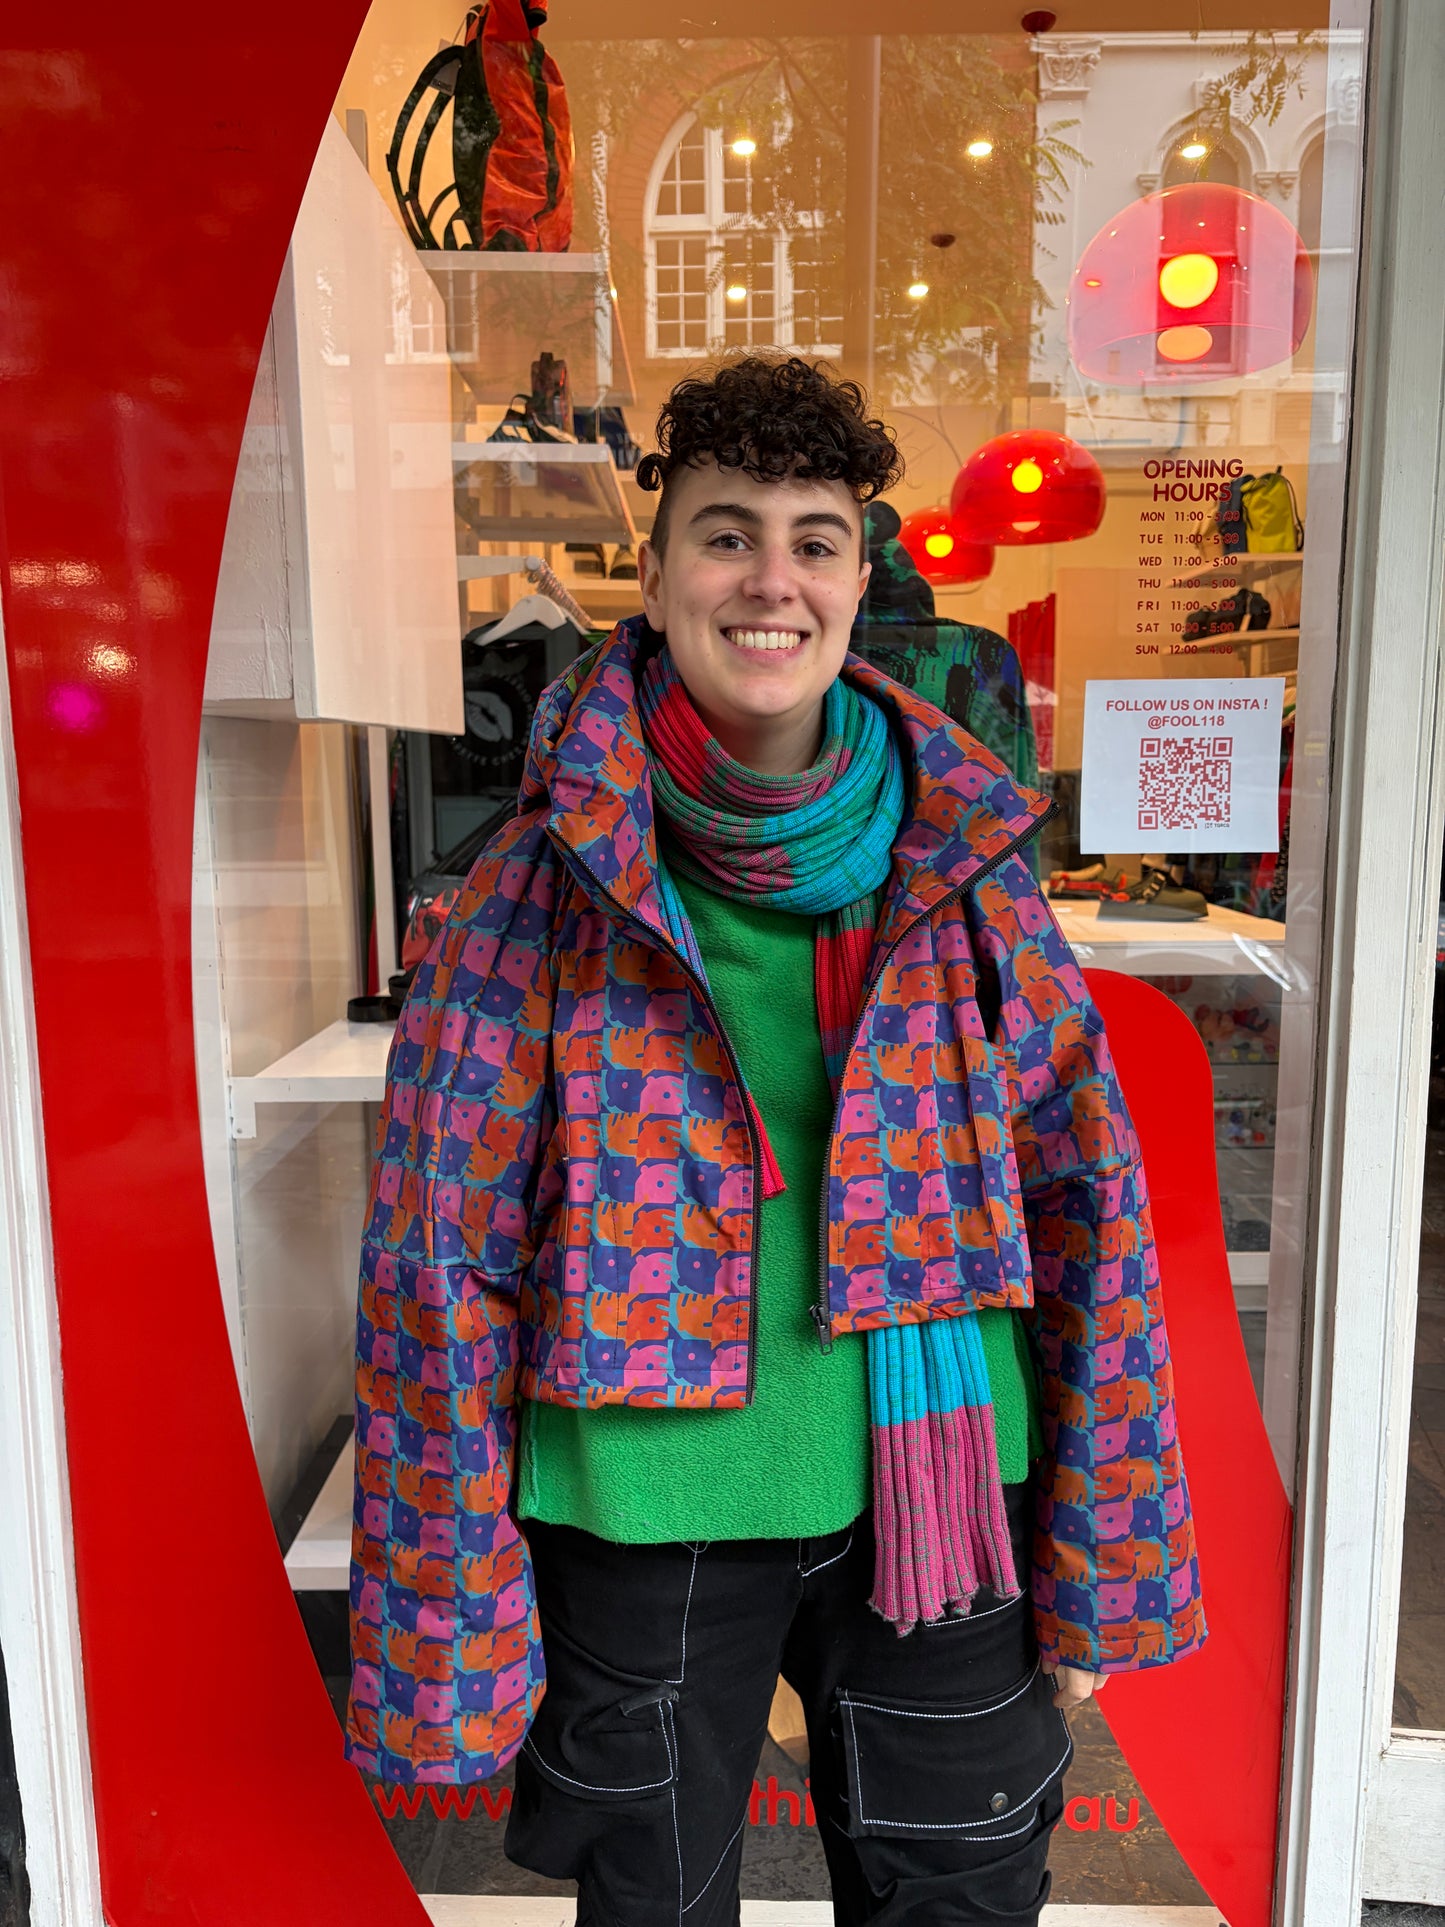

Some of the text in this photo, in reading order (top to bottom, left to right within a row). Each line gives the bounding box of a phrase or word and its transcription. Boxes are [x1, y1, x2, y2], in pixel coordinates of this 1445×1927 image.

[1143, 458, 1244, 479] OPENING
[1153, 482, 1232, 502] HOURS
[1140, 511, 1165, 522] MON
[1174, 511, 1204, 521] 11:00
[1139, 534, 1163, 544] TUE
[1173, 534, 1203, 544] 11:00
[1138, 556, 1162, 566] WED
[1172, 556, 1201, 566] 11:00
[1212, 556, 1238, 567] 5:00
[1138, 579, 1161, 588] THU
[1137, 601, 1160, 611] FRI
[1171, 600, 1200, 611] 11:00
[1136, 623, 1160, 633] SAT
[1170, 622, 1200, 633] 10:00
[1209, 622, 1235, 633] 5:00
[1135, 645, 1159, 655] SUN
[1169, 645, 1198, 654] 12:00
[1106, 699, 1167, 712] FOLLOW
[1170, 699, 1190, 711] US
[1193, 699, 1214, 711] ON
[1217, 698, 1260, 710] INSTA
[1147, 715, 1225, 730] @FOOL118
